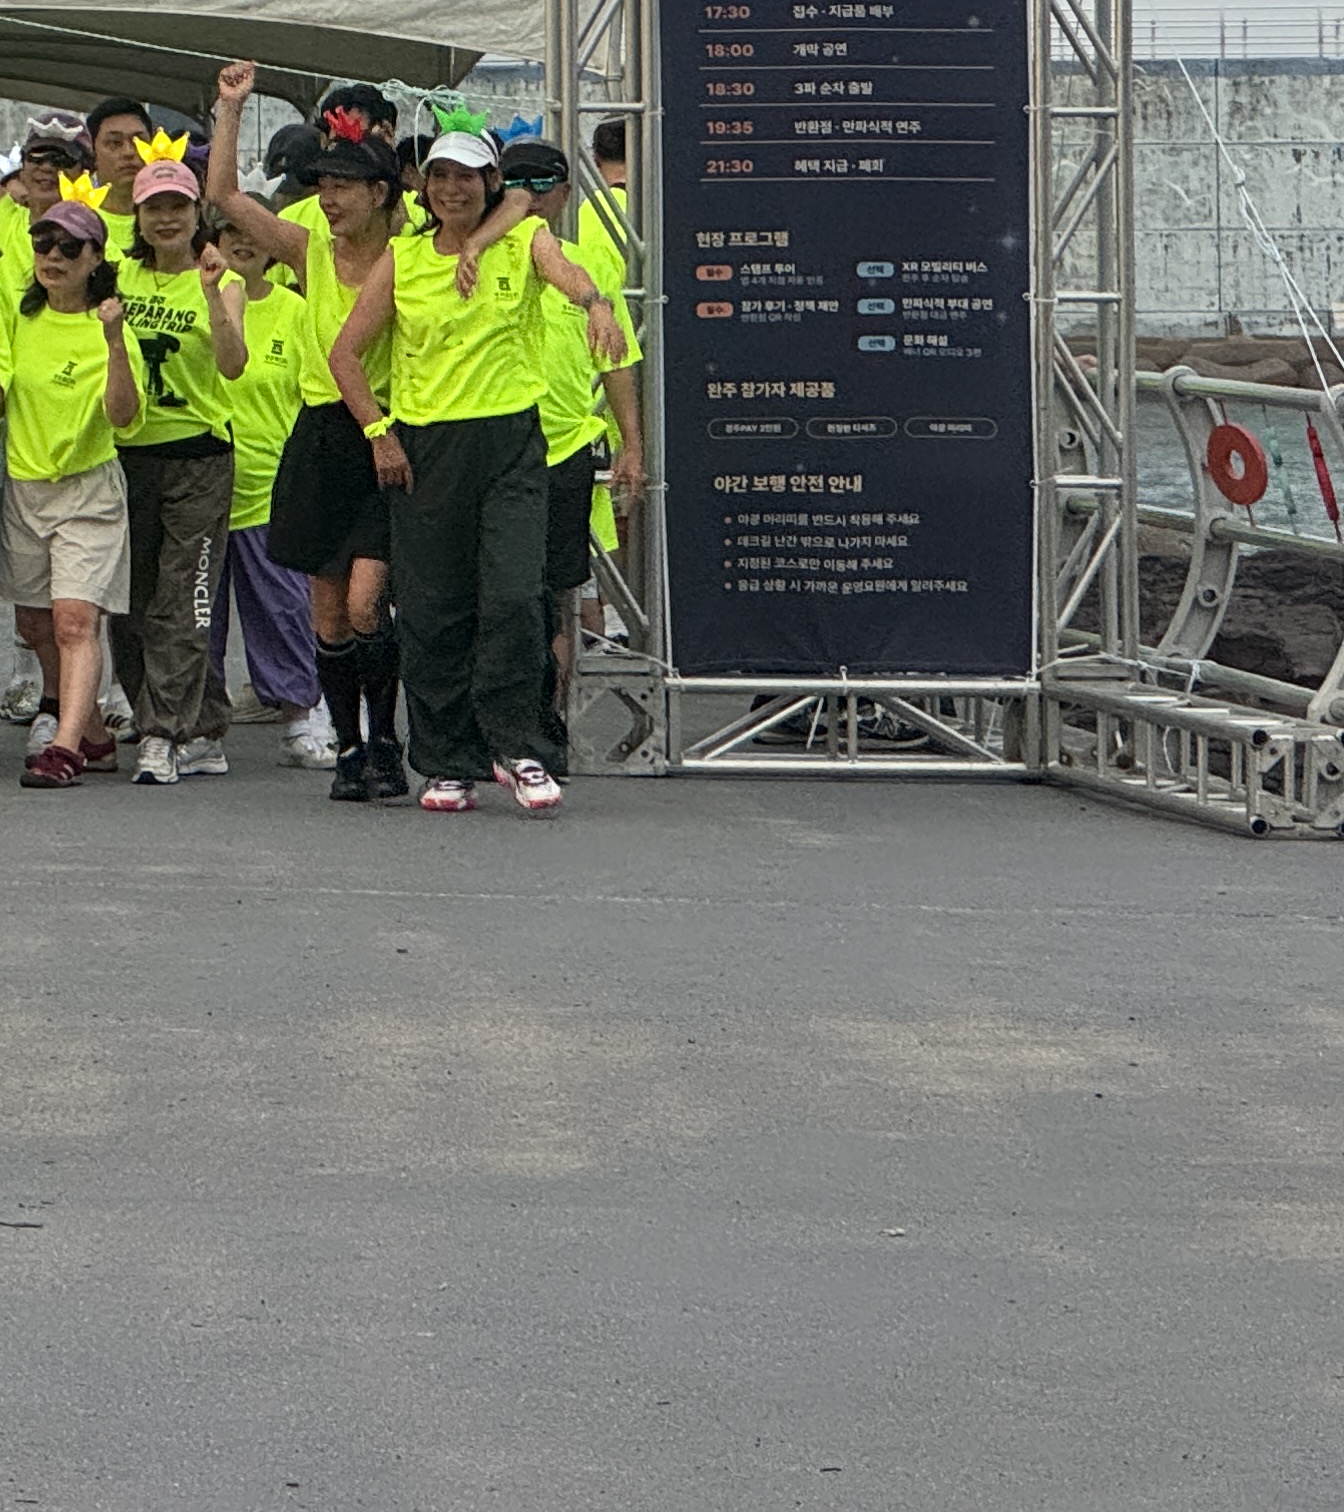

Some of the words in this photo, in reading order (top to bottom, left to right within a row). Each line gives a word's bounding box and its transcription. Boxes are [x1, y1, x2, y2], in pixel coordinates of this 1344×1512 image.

[704, 5, 751, 20] 17:30
[705, 43, 754, 58] 18:00
[706, 82, 755, 97] 18:30
[706, 121, 754, 136] 19:35
[706, 159, 754, 174] 21:30
[194, 536, 212, 629] MONCLER
